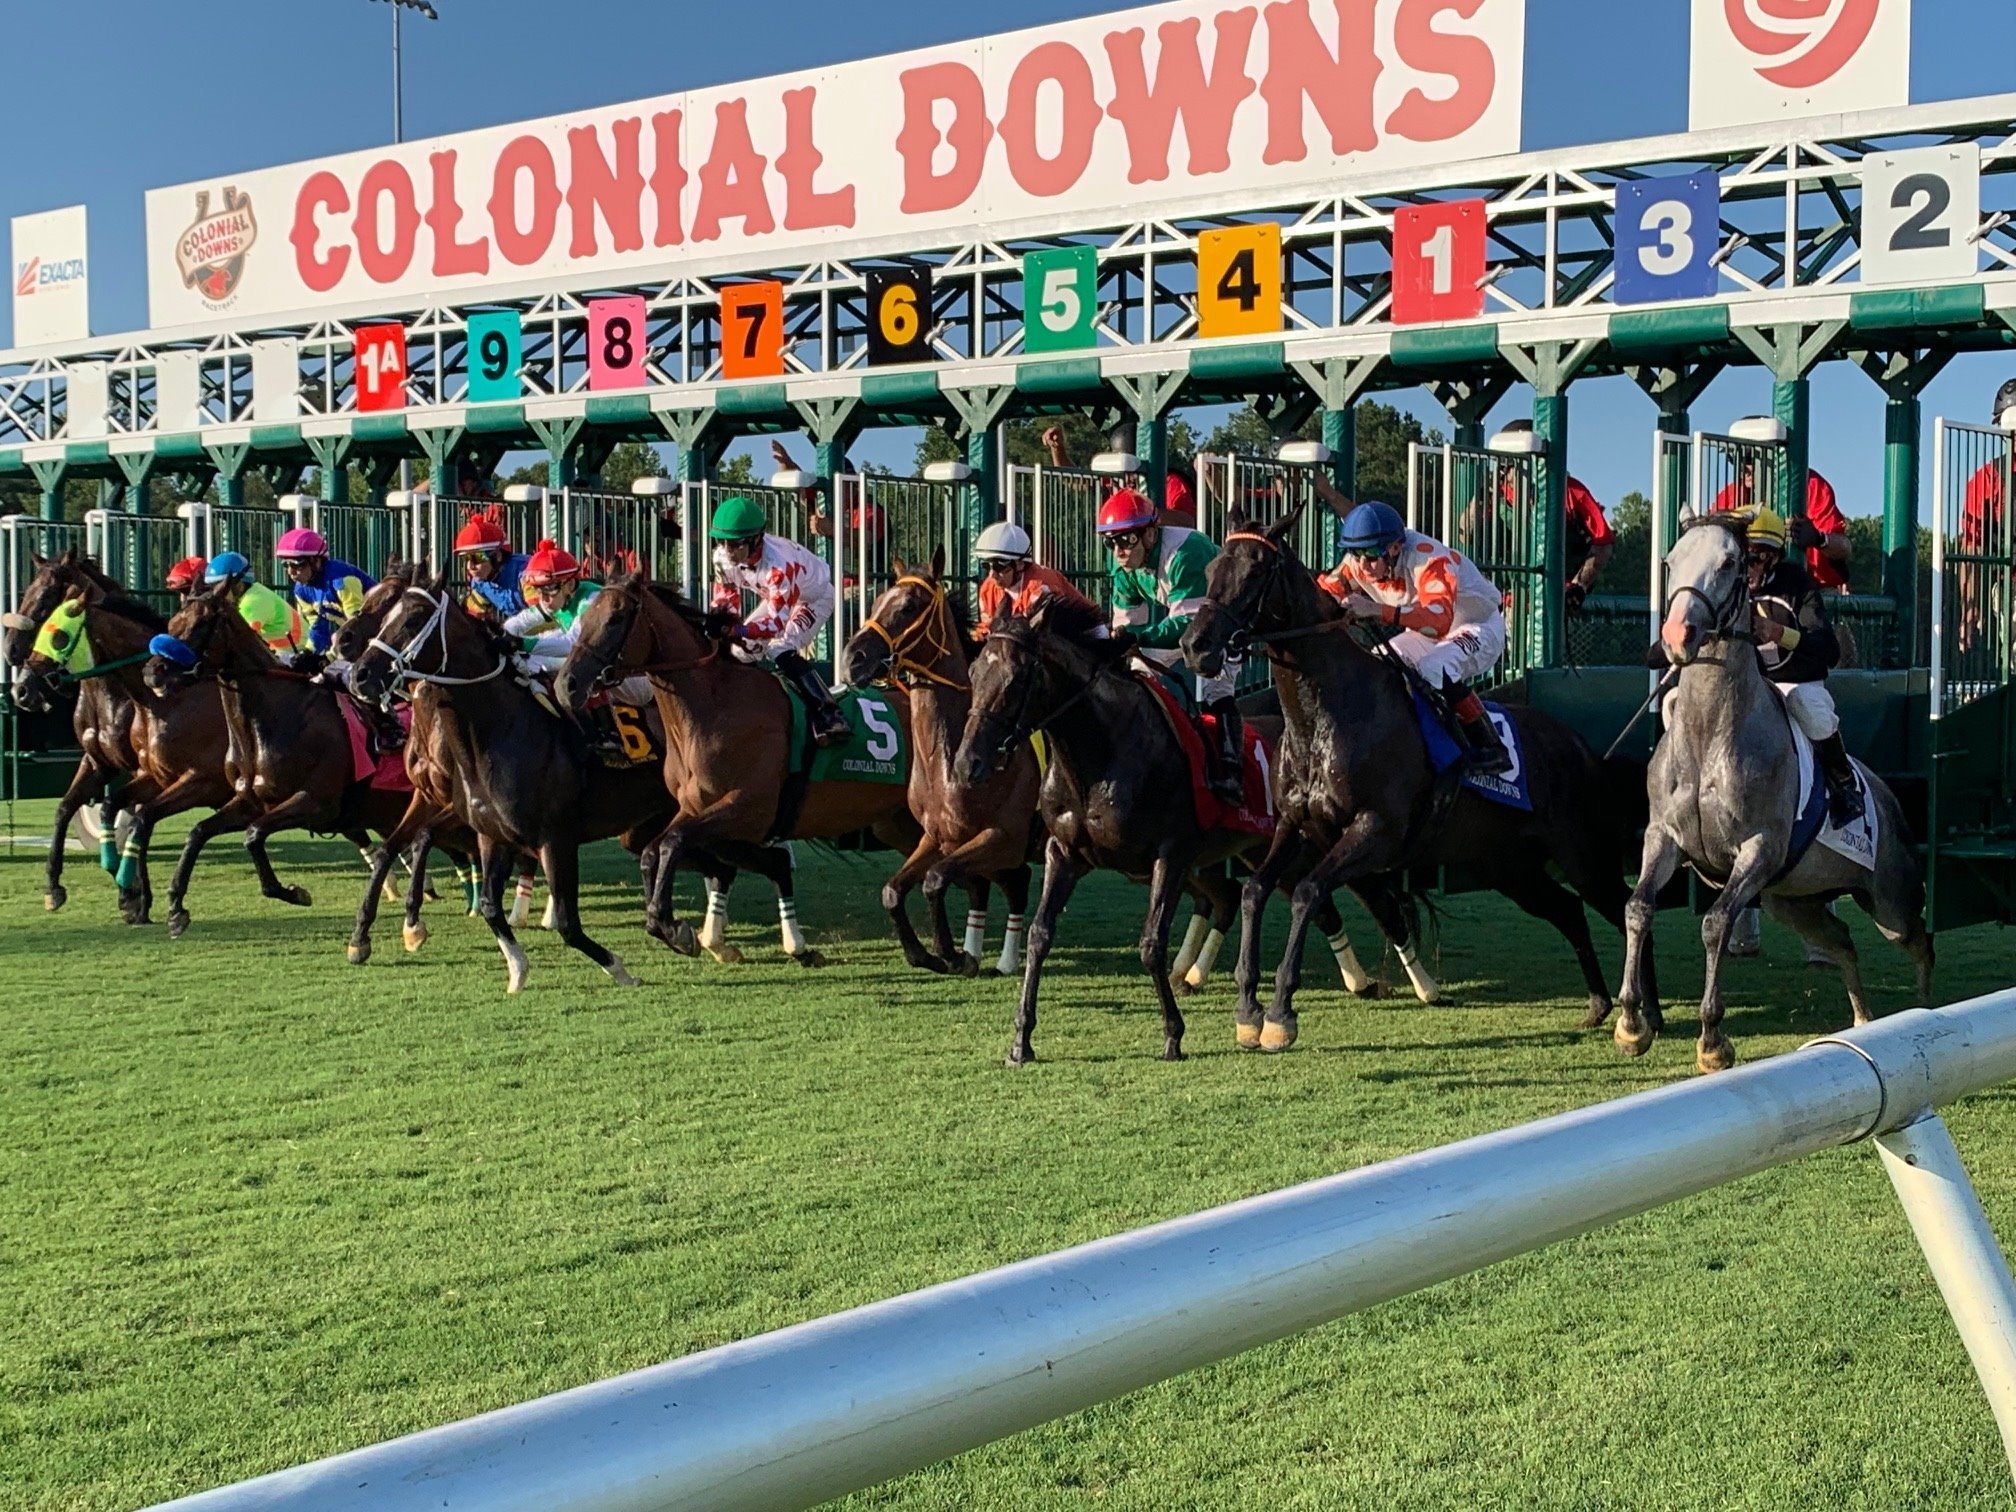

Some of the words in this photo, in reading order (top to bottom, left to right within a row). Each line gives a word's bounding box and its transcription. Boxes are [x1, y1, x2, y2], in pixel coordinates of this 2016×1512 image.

[289, 86, 856, 292] COLONIAL
[895, 0, 1495, 215] DOWNS
[183, 214, 249, 257] COLONIAL
[1638, 200, 1694, 276] 3
[1889, 173, 1951, 251] 2
[40, 259, 84, 285] EXACTA
[197, 236, 238, 262] DOWNS
[1420, 225, 1452, 294] 1
[1039, 268, 1080, 332] 5
[1217, 249, 1261, 312] 4
[603, 317, 633, 370] 8
[736, 303, 766, 358] 7
[880, 284, 919, 345] 6
[360, 340, 401, 393] 1A
[480, 330, 509, 381] 9
[613, 705, 652, 759] 6
[856, 697, 898, 761] 5
